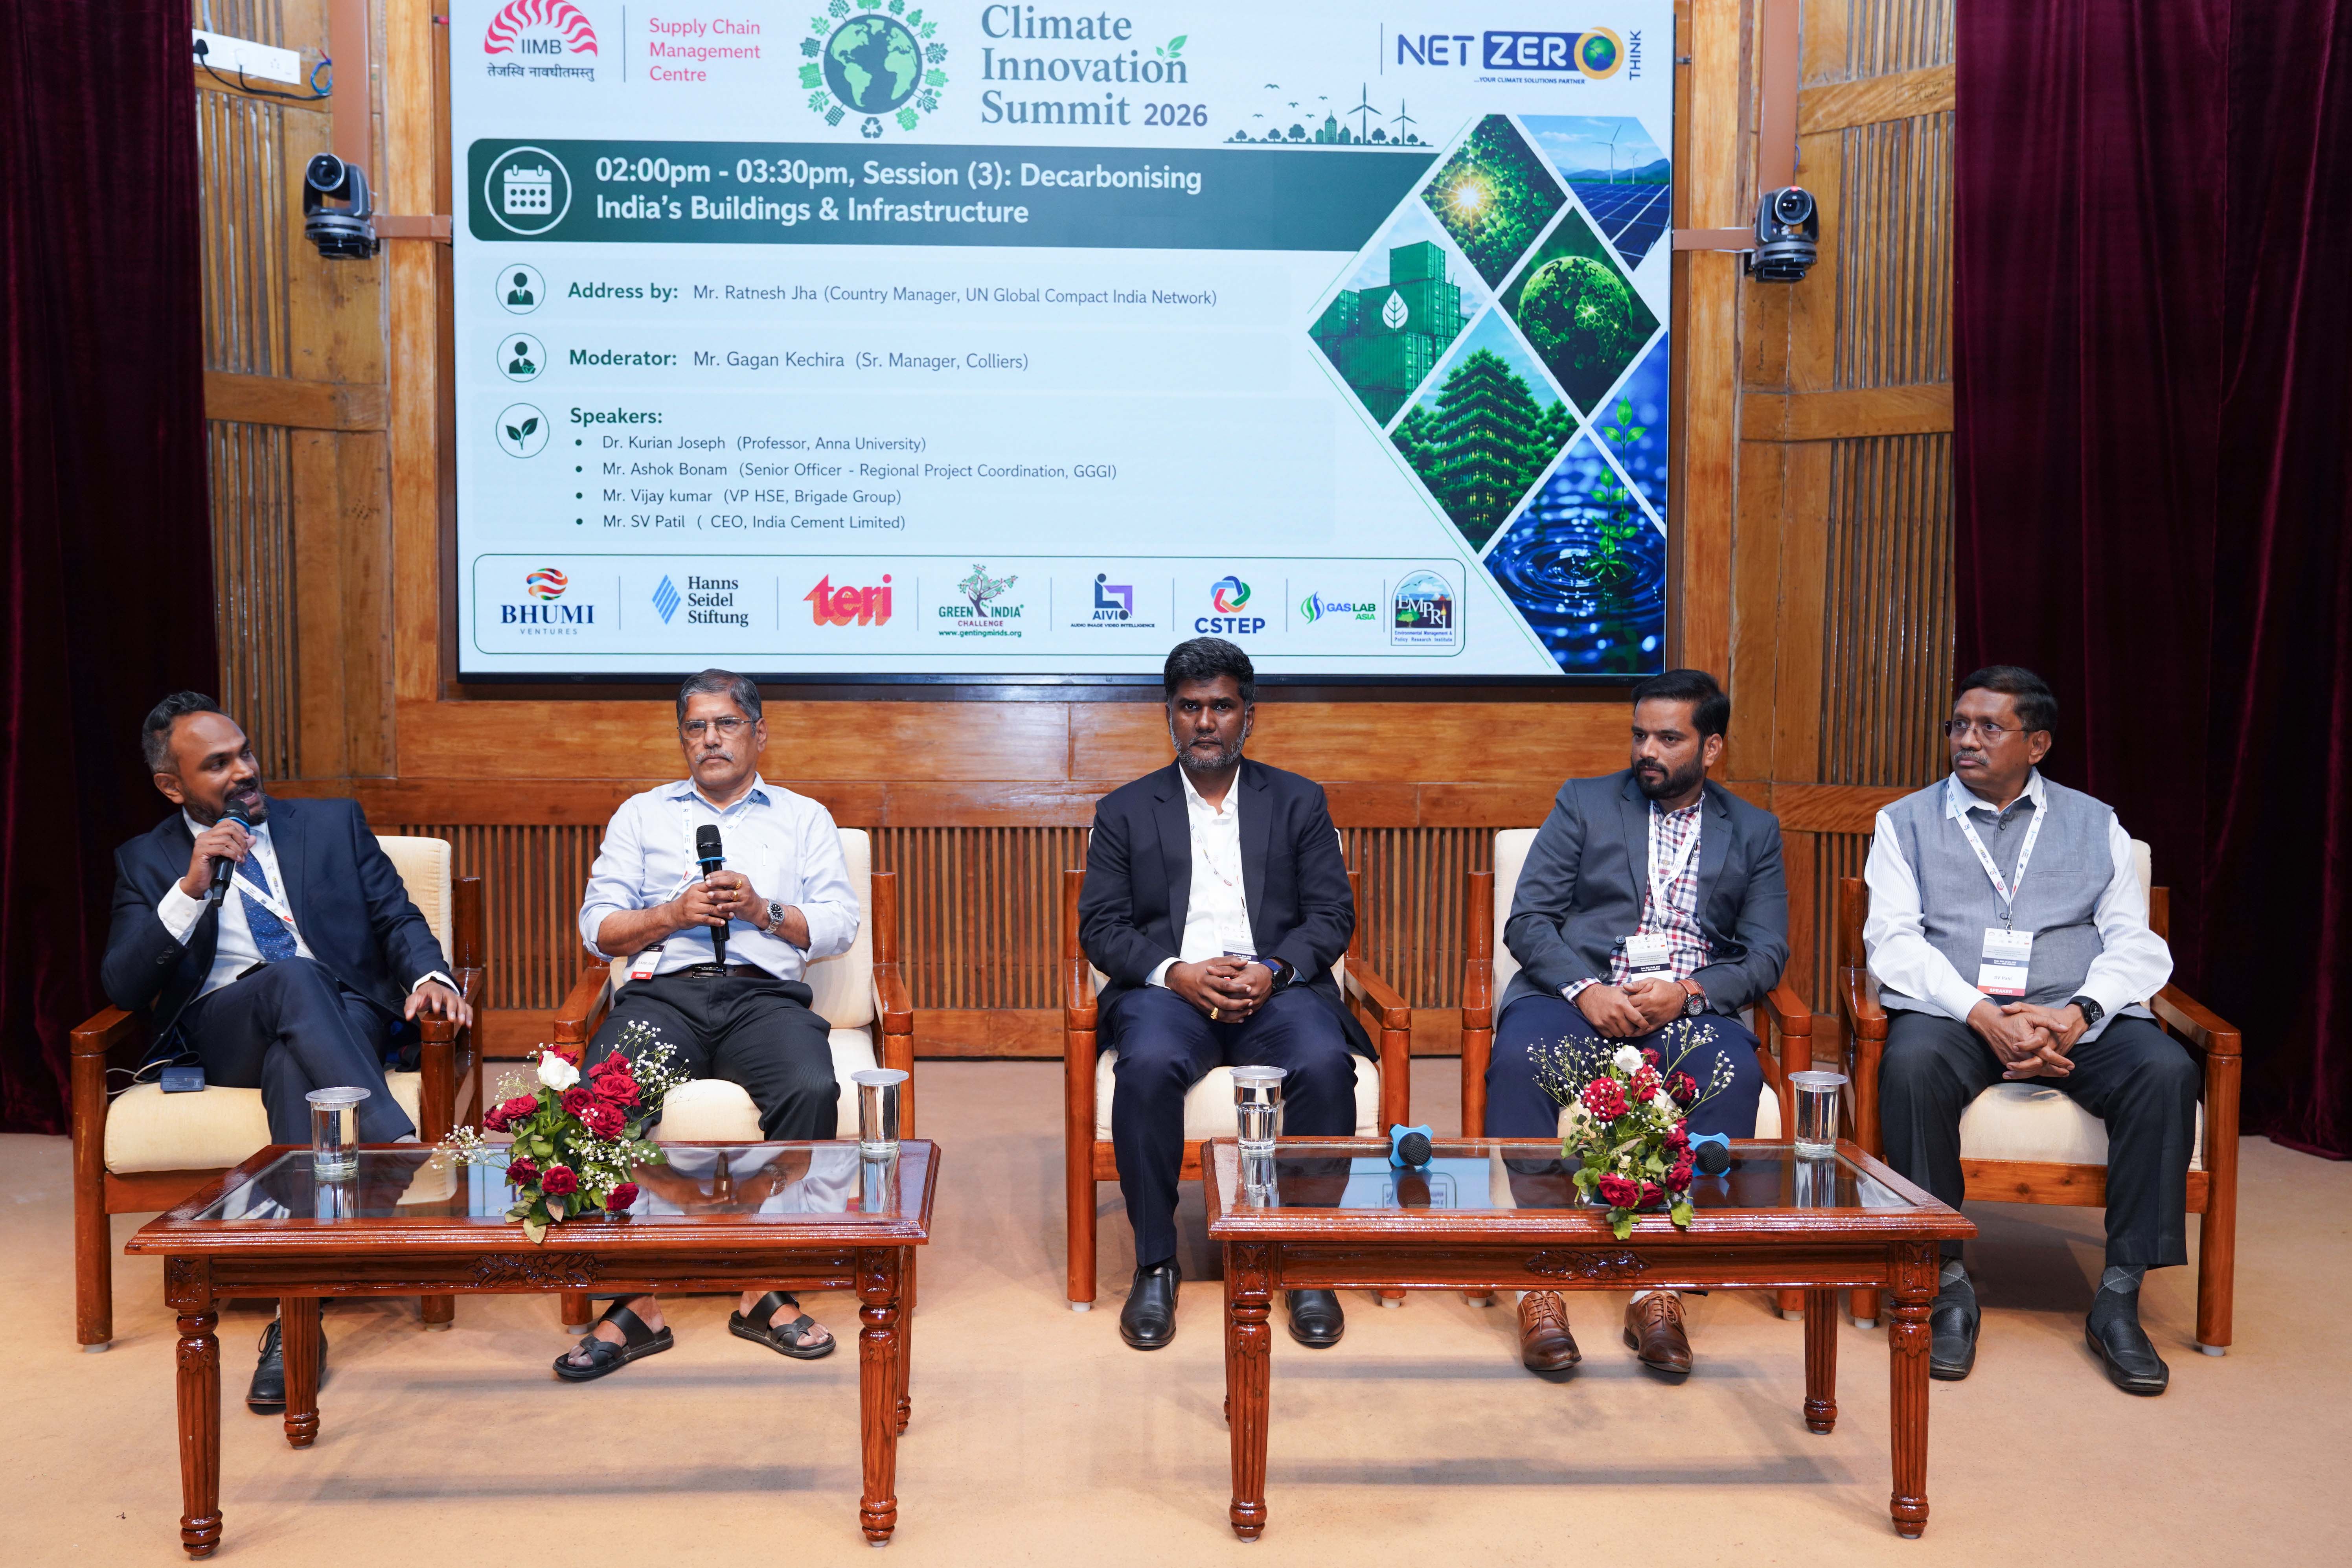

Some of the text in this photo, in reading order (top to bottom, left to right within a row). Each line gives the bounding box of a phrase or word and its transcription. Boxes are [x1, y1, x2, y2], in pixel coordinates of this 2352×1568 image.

[649, 17, 760, 38] Supply Chain
[982, 4, 1132, 41] Climate
[522, 39, 562, 55] IIMB
[650, 41, 761, 62] Management
[1398, 34, 1475, 66] NET
[1629, 30, 1641, 81] THINK
[649, 65, 707, 82] Centre
[982, 48, 1188, 84] Innovation
[982, 90, 1208, 127] Summit 2026
[596, 157, 710, 188] 02:00pm
[736, 159, 855, 189] 03:30pm,
[863, 160, 958, 185] Session
[967, 160, 1011, 190] (3):
[1021, 162, 1201, 195] Decarbonising
[597, 194, 1029, 227] India’s Buildings & Infrastructure
[568, 282, 1217, 307] Address by: Mr. Ratnesh Jha (Country Manager, UN Global Compact India Network)
[570, 349, 1028, 371] Moderator: Mr. Gagan Kechira (Sr. Manager, Colliers)
[570, 407, 662, 428] Speakers:
[603, 436, 926, 453] Dr. Kurian Joseph (Professor, Anna University)
[603, 462, 625, 475] Mr.
[631, 462, 673, 475] Ashok
[679, 462, 727, 475] Bonam
[739, 462, 789, 478] (Senior
[794, 463, 842, 476] Officer
[860, 463, 919, 480] Regional
[925, 463, 973, 480] Project
[978, 464, 1068, 479] Coordination,
[1074, 464, 1116, 480] GGGI)
[603, 489, 901, 506] Mr. Vijay kumar (VP HSE, Brigade Group)
[604, 515, 625, 528] Mr.
[631, 515, 650, 528] SV
[655, 515, 685, 528] Patil
[711, 515, 747, 529] CEO,
[753, 515, 786, 528] India
[791, 515, 844, 528] Cement
[850, 515, 905, 531] Limited)
[688, 576, 739, 590] Hanns
[688, 592, 733, 607] Seidel
[803, 574, 892, 625] teri
[501, 605, 594, 624] BHUMI
[688, 609, 749, 628] Stiftung
[939, 606, 973, 618] GREEN
[1194, 617, 1265, 634] CSTEP
